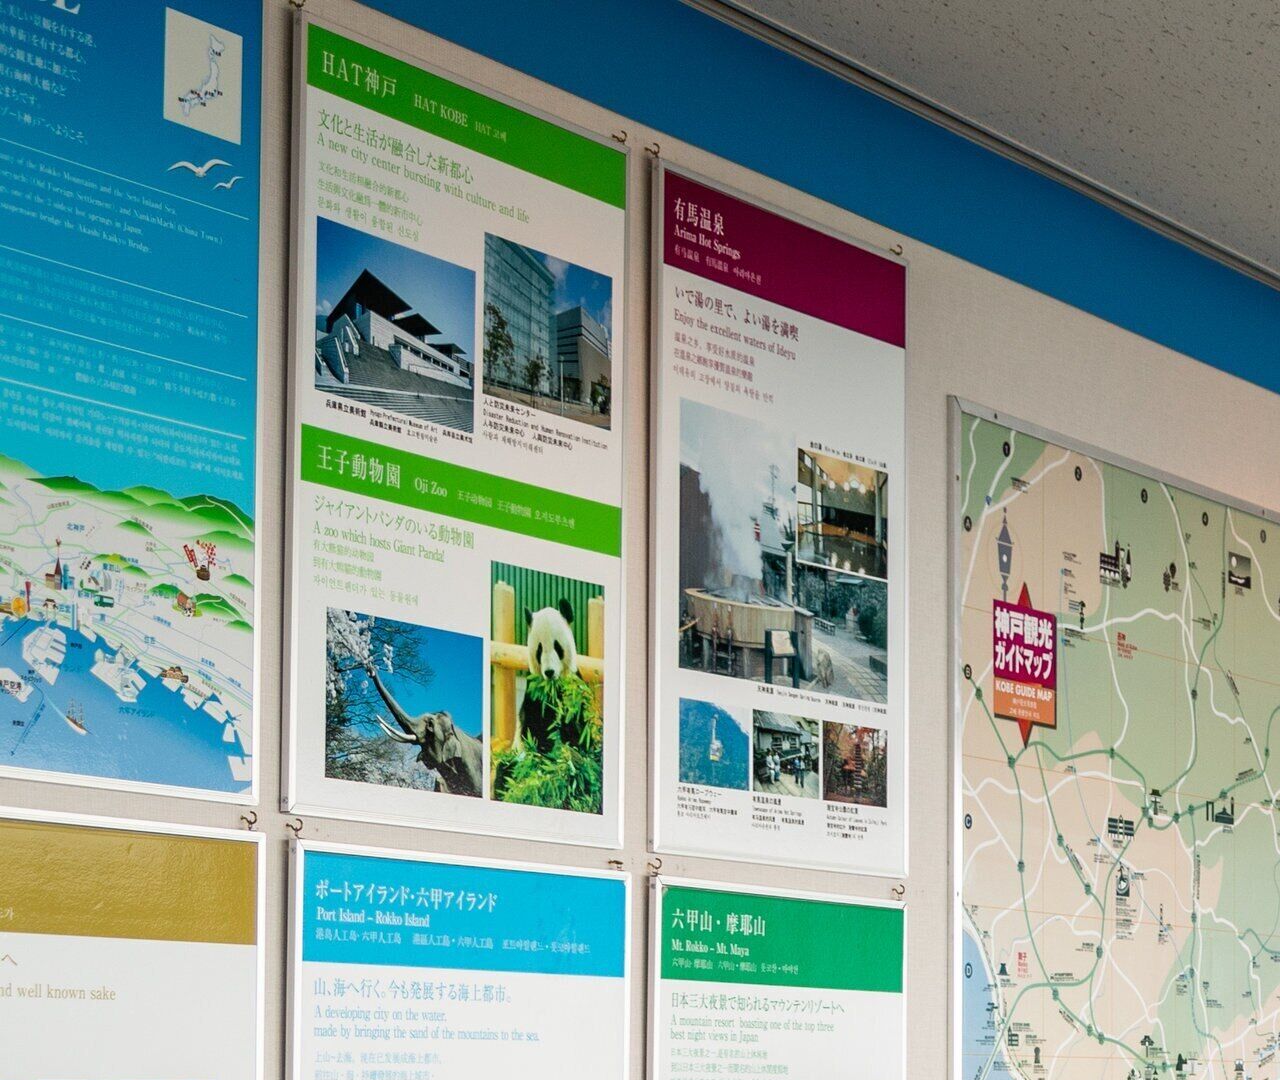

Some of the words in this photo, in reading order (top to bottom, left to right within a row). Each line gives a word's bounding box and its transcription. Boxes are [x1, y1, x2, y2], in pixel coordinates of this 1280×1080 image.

[322, 50, 397, 99] HAT神戸
[413, 94, 436, 115] HAT
[440, 102, 469, 128] KOBE
[318, 109, 474, 185] 文化と生活が融合した新都心
[317, 132, 325, 146] A
[328, 138, 348, 155] new
[351, 143, 369, 162] city
[371, 152, 401, 175] center
[403, 165, 441, 193] bursting
[444, 179, 464, 201] with
[465, 188, 497, 214] culture
[499, 201, 515, 221] and
[517, 206, 530, 225] life
[673, 197, 725, 236] 有馬温泉
[674, 224, 697, 242] Arima
[698, 232, 712, 247] Hot
[713, 237, 741, 260] Springs
[674, 307, 695, 329] Enjoy
[697, 316, 709, 332] the
[710, 320, 742, 344] excellent
[743, 333, 767, 352] waters
[767, 340, 776, 353] of
[317, 444, 400, 489] 王子動物園
[414, 476, 429, 494] Oji
[431, 482, 448, 498] Zoo
[313, 495, 475, 550] ジャイアントパンダのいる動物園
[313, 520, 321, 535] A
[324, 526, 338, 538] zoo
[341, 528, 367, 545] which
[369, 533, 391, 551] hosts
[393, 538, 416, 556] Giant
[995, 606, 1053, 650] 神戸観光
[995, 640, 1053, 680] ガイドマップ
[995, 680, 1014, 695] KOBE
[1015, 684, 1036, 699] GUIDE
[1036, 689, 1053, 702] MAP
[315, 879, 498, 913] ポートアイランド・六甲アイランド
[316, 907, 336, 922] Port
[339, 908, 365, 924] Island
[375, 910, 402, 927] Rokko
[404, 912, 430, 928] Island
[672, 908, 767, 937] 六甲山・摩耶山
[671, 938, 684, 952] Mt.
[686, 939, 709, 953] Rokko
[716, 942, 729, 955] Mt.
[730, 943, 750, 957] Maya
[16, 984, 42, 999] well
[47, 984, 86, 1000] known
[90, 985, 116, 1001] sake
[314, 978, 512, 1004] 山、海へ行く。今も発展する海上都市。
[314, 1006, 323, 1018] A
[325, 1007, 370, 1022] developing
[373, 1007, 389, 1022] city
[392, 1011, 403, 1021] on
[405, 1009, 418, 1021] the
[671, 1015, 678, 1027] A
[679, 1016, 712, 1028] mountain
[714, 1016, 735, 1029] resort
[739, 1017, 768, 1031] boasting
[770, 1022, 782, 1031] one
[783, 1020, 791, 1031] of
[792, 1021, 803, 1031] the
[804, 1022, 815, 1033] top
[817, 1022, 834, 1032] three
[314, 1025, 336, 1038] made
[340, 1026, 351, 1040] by
[354, 1025, 390, 1041] bringing
[393, 1026, 407, 1039] the
[409, 1026, 429, 1040] sand
[430, 1026, 440, 1039] of
[442, 1027, 455, 1040] the
[457, 1028, 499, 1041] mountains
[500, 1030, 509, 1041] to
[511, 1028, 523, 1041] the
[670, 1029, 685, 1041] best
[687, 1030, 706, 1043] night
[708, 1031, 728, 1043] views
[730, 1031, 737, 1042] in
[738, 1032, 759, 1045] Japan
